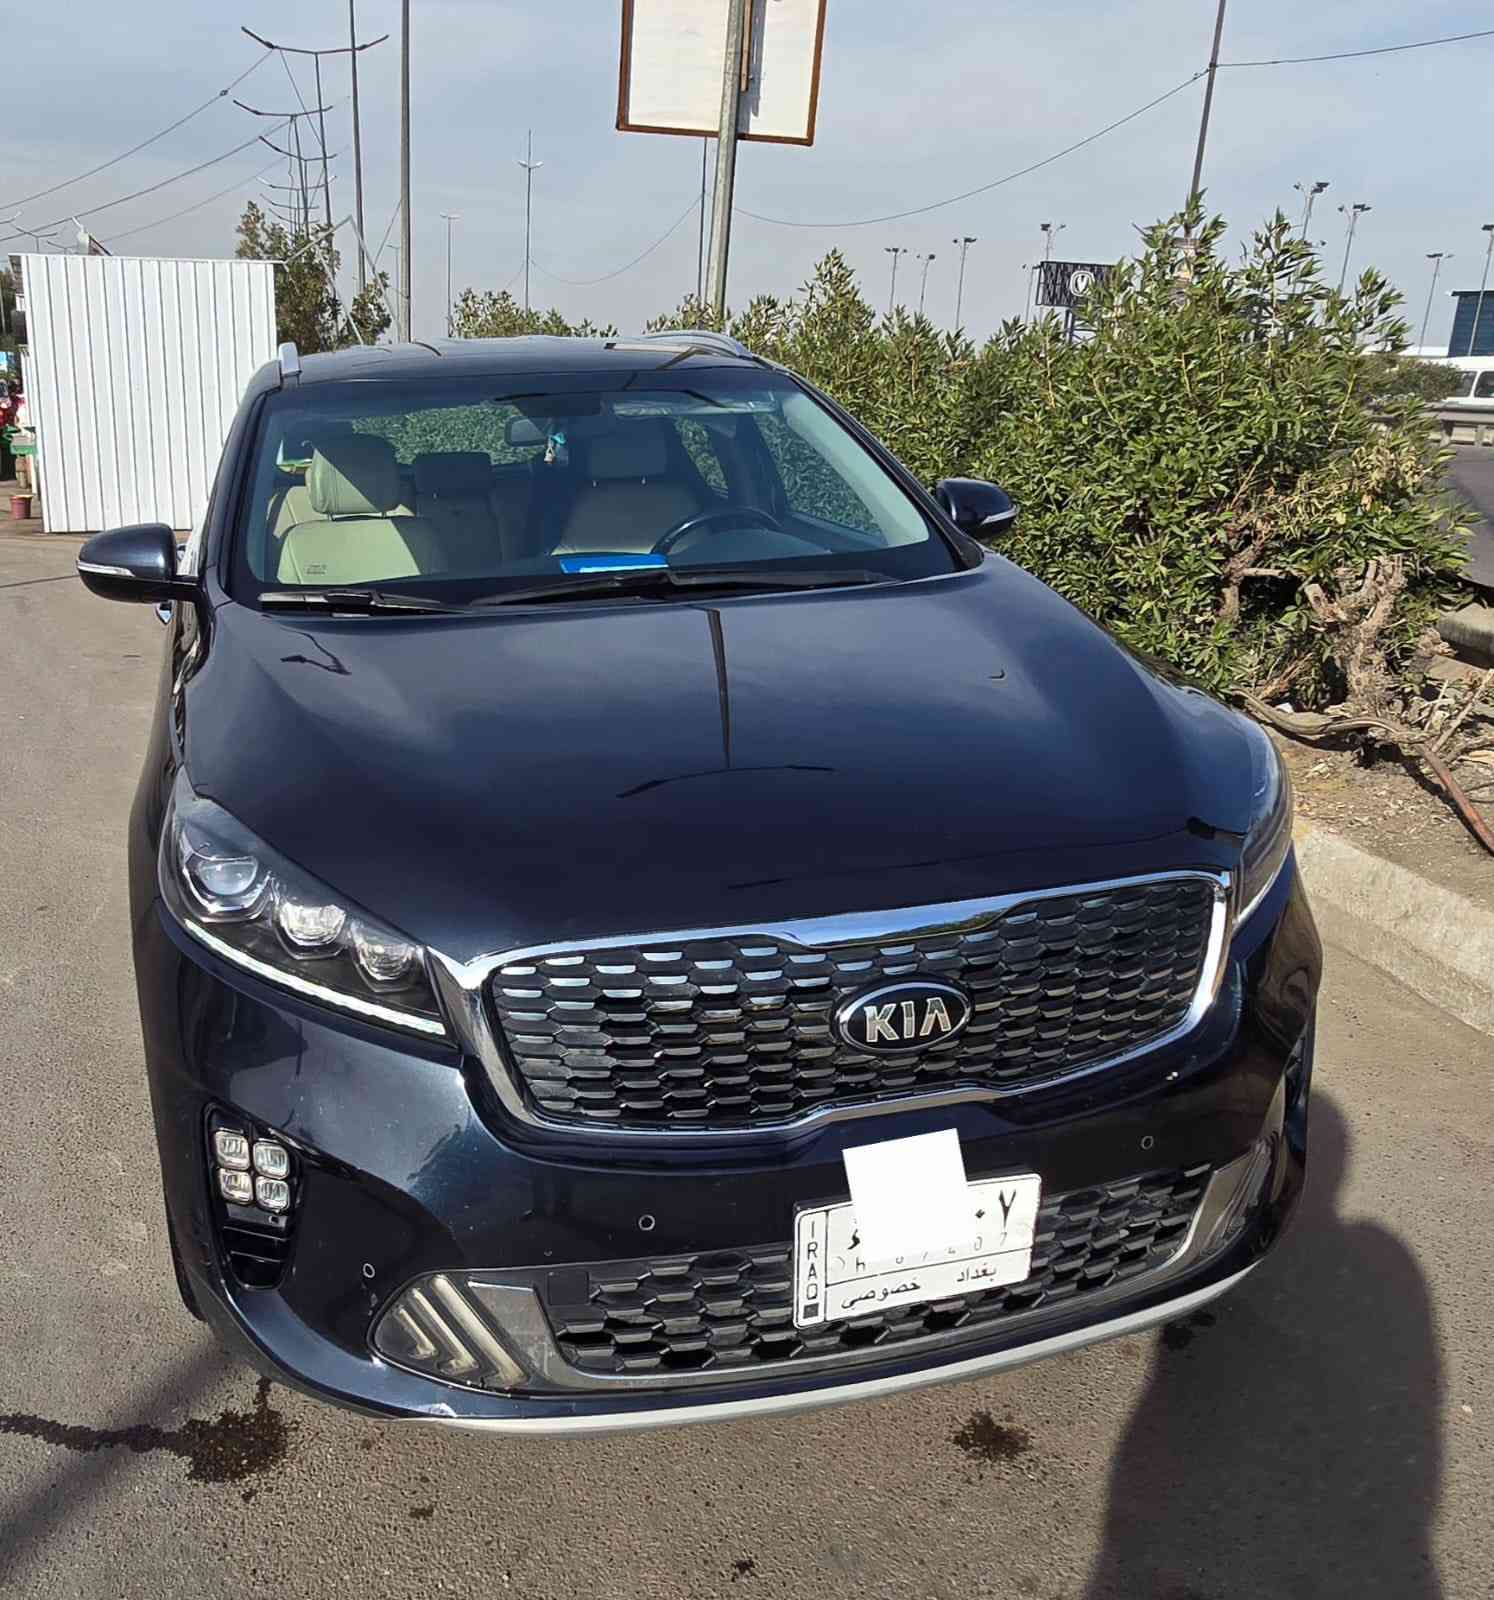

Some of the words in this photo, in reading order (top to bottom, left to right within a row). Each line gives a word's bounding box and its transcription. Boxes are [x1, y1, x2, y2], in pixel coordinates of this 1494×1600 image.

[864, 997, 951, 1043] KIA
[806, 1220, 819, 1300] IRAQ
[956, 1261, 998, 1283] بغداد
[841, 1276, 921, 1311] خصوصي
